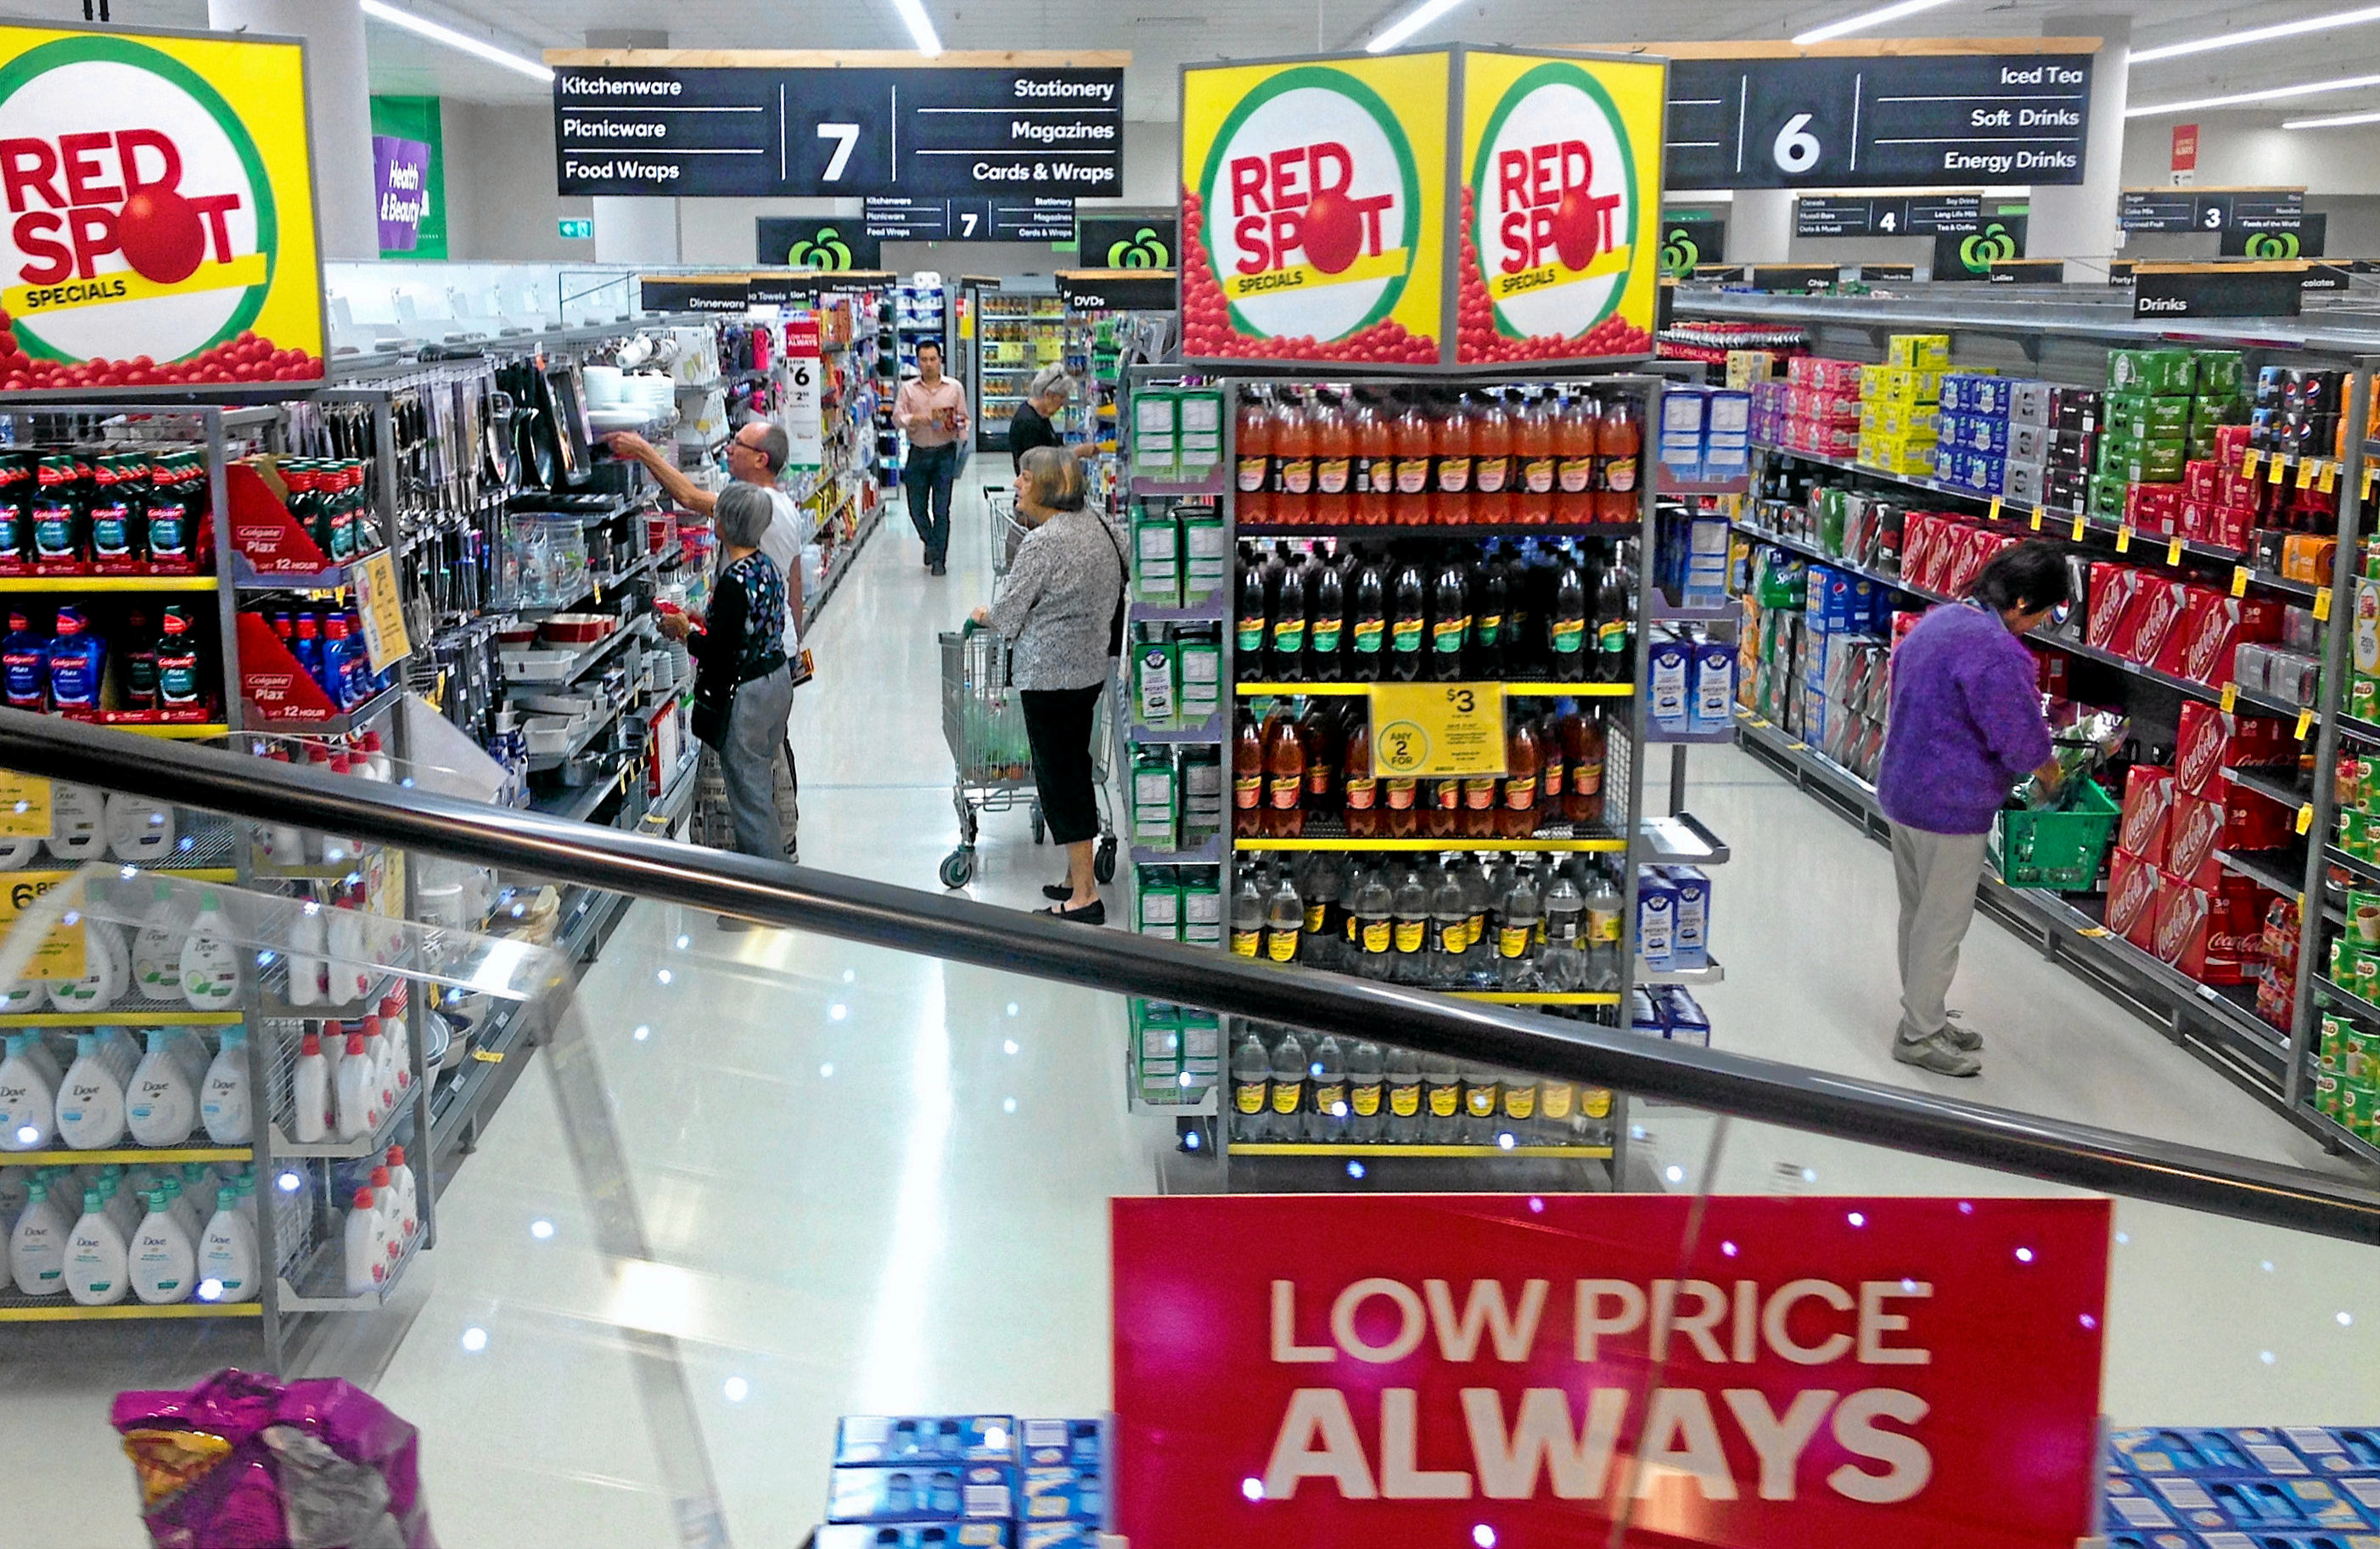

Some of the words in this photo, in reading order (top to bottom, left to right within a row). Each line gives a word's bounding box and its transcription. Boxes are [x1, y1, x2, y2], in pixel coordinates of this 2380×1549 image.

[561, 76, 682, 97] Kitchenware
[2001, 66, 2040, 86] Iced
[2046, 66, 2084, 87] Tea
[1013, 79, 1114, 101] Stationery
[1970, 108, 2012, 128] Soft
[2018, 109, 2080, 127] Drinks
[563, 119, 666, 139] Picnicware
[1011, 121, 1114, 143] Magazines
[816, 122, 861, 182] 7
[1772, 113, 1821, 173] 6
[0, 129, 181, 213] RED
[564, 161, 615, 179] Food
[617, 161, 680, 182] Wraps
[1944, 151, 2012, 174] Energy
[2016, 150, 2077, 169] Drinks
[389, 159, 419, 191] Health
[972, 162, 1028, 182] Cards
[1033, 163, 1047, 181] &
[1052, 162, 1114, 184] Wraps
[1230, 142, 1354, 218] RED
[1498, 139, 1593, 213] RED
[380, 192, 389, 222] &
[389, 192, 420, 232] Beauty
[1879, 211, 1897, 233] 4
[2204, 208, 2221, 228] 3
[961, 214, 978, 238] 7
[1238, 271, 1304, 294] SPECIALS
[1502, 269, 1556, 294] SPECIALS
[1807, 278, 1830, 289] Chips
[1990, 273, 2014, 283] Lollies
[2111, 276, 2132, 285] Party
[25, 280, 127, 308] SPECIALS
[689, 298, 745, 310] Dinnerware
[758, 293, 786, 302] Towels
[1074, 296, 1105, 307] DVDs
[2138, 298, 2188, 312] Drinks
[239, 527, 280, 538] Colgate
[246, 541, 277, 553] Plax
[276, 558, 291, 570] 12
[248, 676, 288, 685] Colgate
[255, 688, 285, 701] Plax
[1446, 688, 1475, 712] $3
[283, 705, 299, 716] 12
[299, 709, 326, 717] HOUR
[1396, 740, 1408, 756] 2
[1391, 756, 1412, 765] FOR
[194, 942, 219, 952] Dove
[0, 1086, 26, 1097] Dove
[73, 1086, 100, 1096] Dove
[143, 1080, 170, 1092] Dove
[212, 1079, 237, 1090] Dove
[25, 1226, 48, 1236] Dove
[143, 1236, 167, 1246] Dove
[210, 1233, 232, 1245] Dove
[76, 1238, 99, 1247] Dove
[1270, 1277, 1547, 1367] LOW
[1573, 1279, 1933, 1367] PRICE
[1261, 1386, 1934, 1503] ALWAYS
